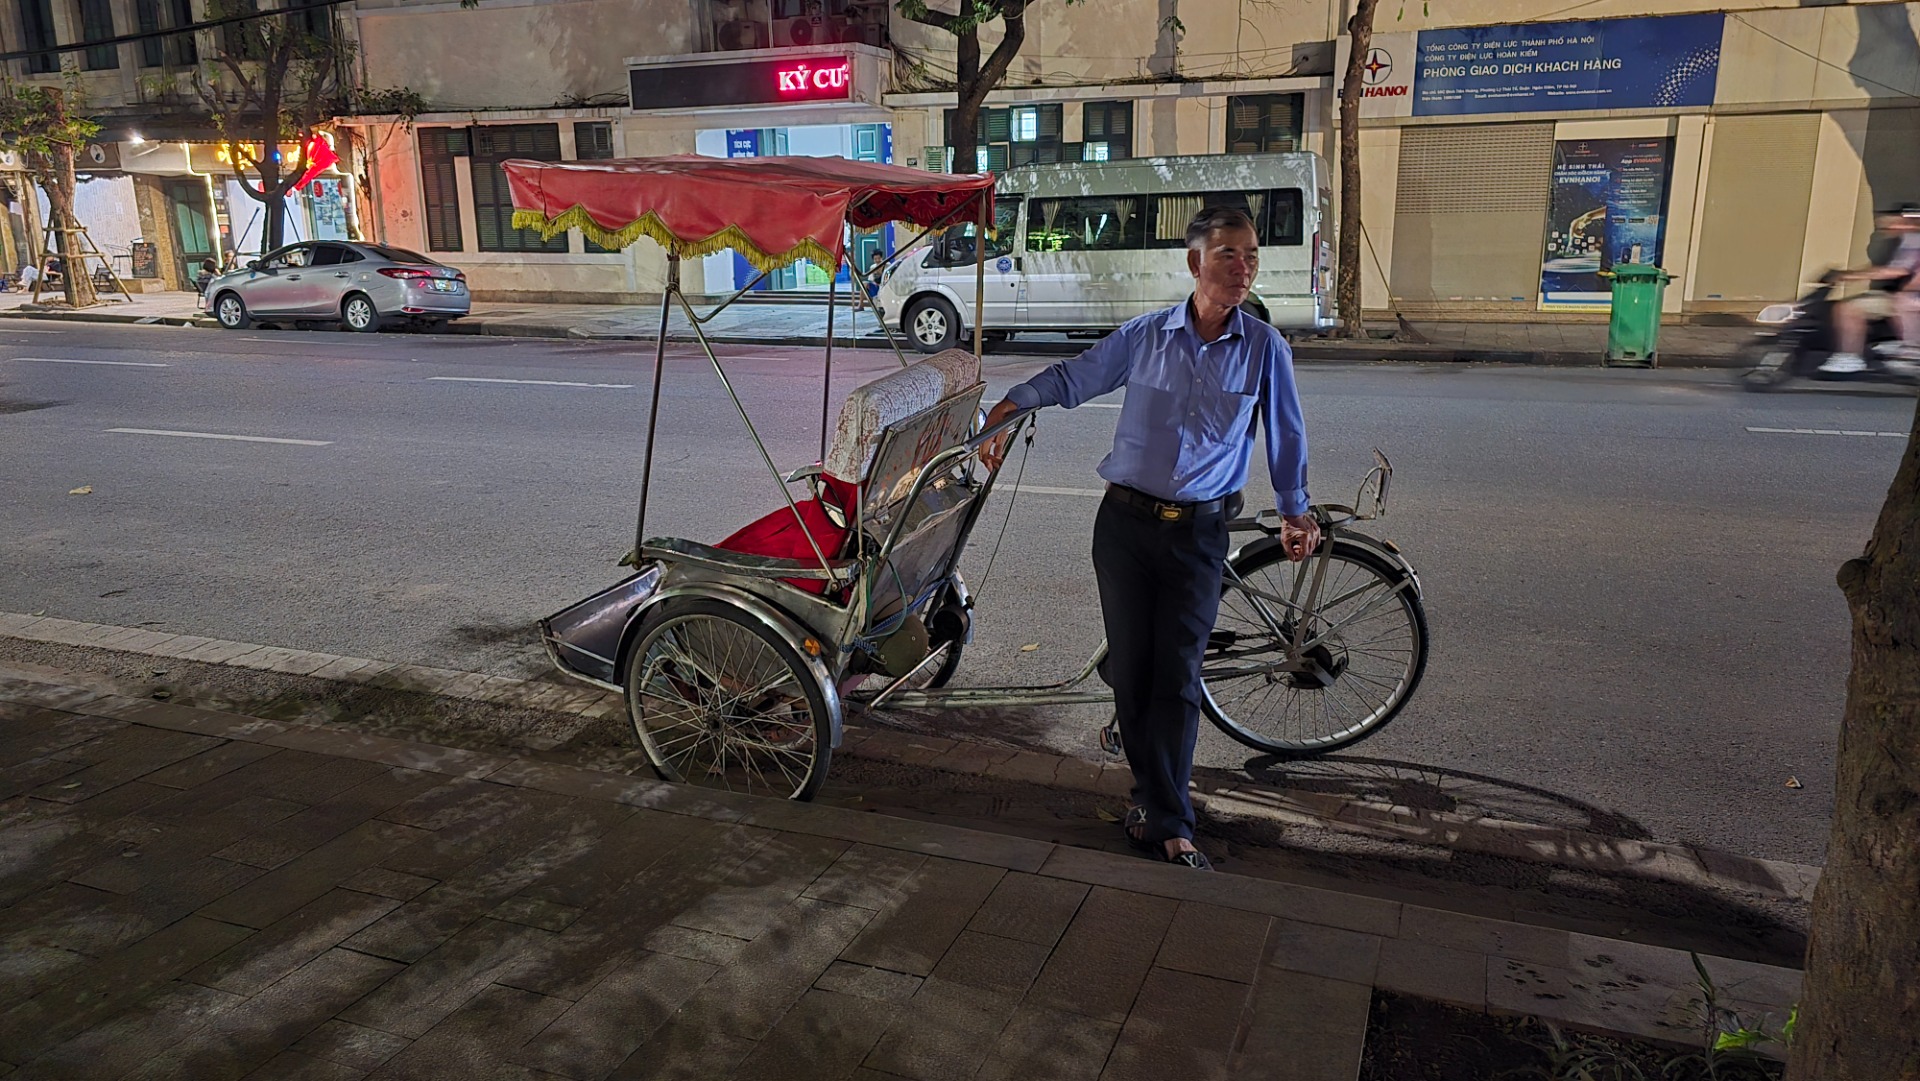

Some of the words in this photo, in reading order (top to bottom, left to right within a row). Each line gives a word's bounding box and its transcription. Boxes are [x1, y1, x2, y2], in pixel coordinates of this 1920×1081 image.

[1426, 44, 1446, 52] TỔNG
[1483, 41, 1501, 49] ĐIỆN
[1503, 40, 1518, 48] LỰC
[1521, 38, 1546, 46] THÀNH
[1581, 35, 1595, 44] NỘI
[1424, 54, 1445, 62] CÔNG
[1459, 53, 1477, 61] ĐIỆN
[1479, 52, 1494, 60] LỰC
[1496, 50, 1517, 59] HOÀN
[1423, 64, 1466, 78] PHÒNG
[1470, 65, 1499, 75] GIAO
[1502, 63, 1532, 76] DỊCH
[1583, 57, 1622, 70] HÀNG
[778, 64, 812, 91] KỶ
[1558, 176, 1601, 184] EVNHANOI
